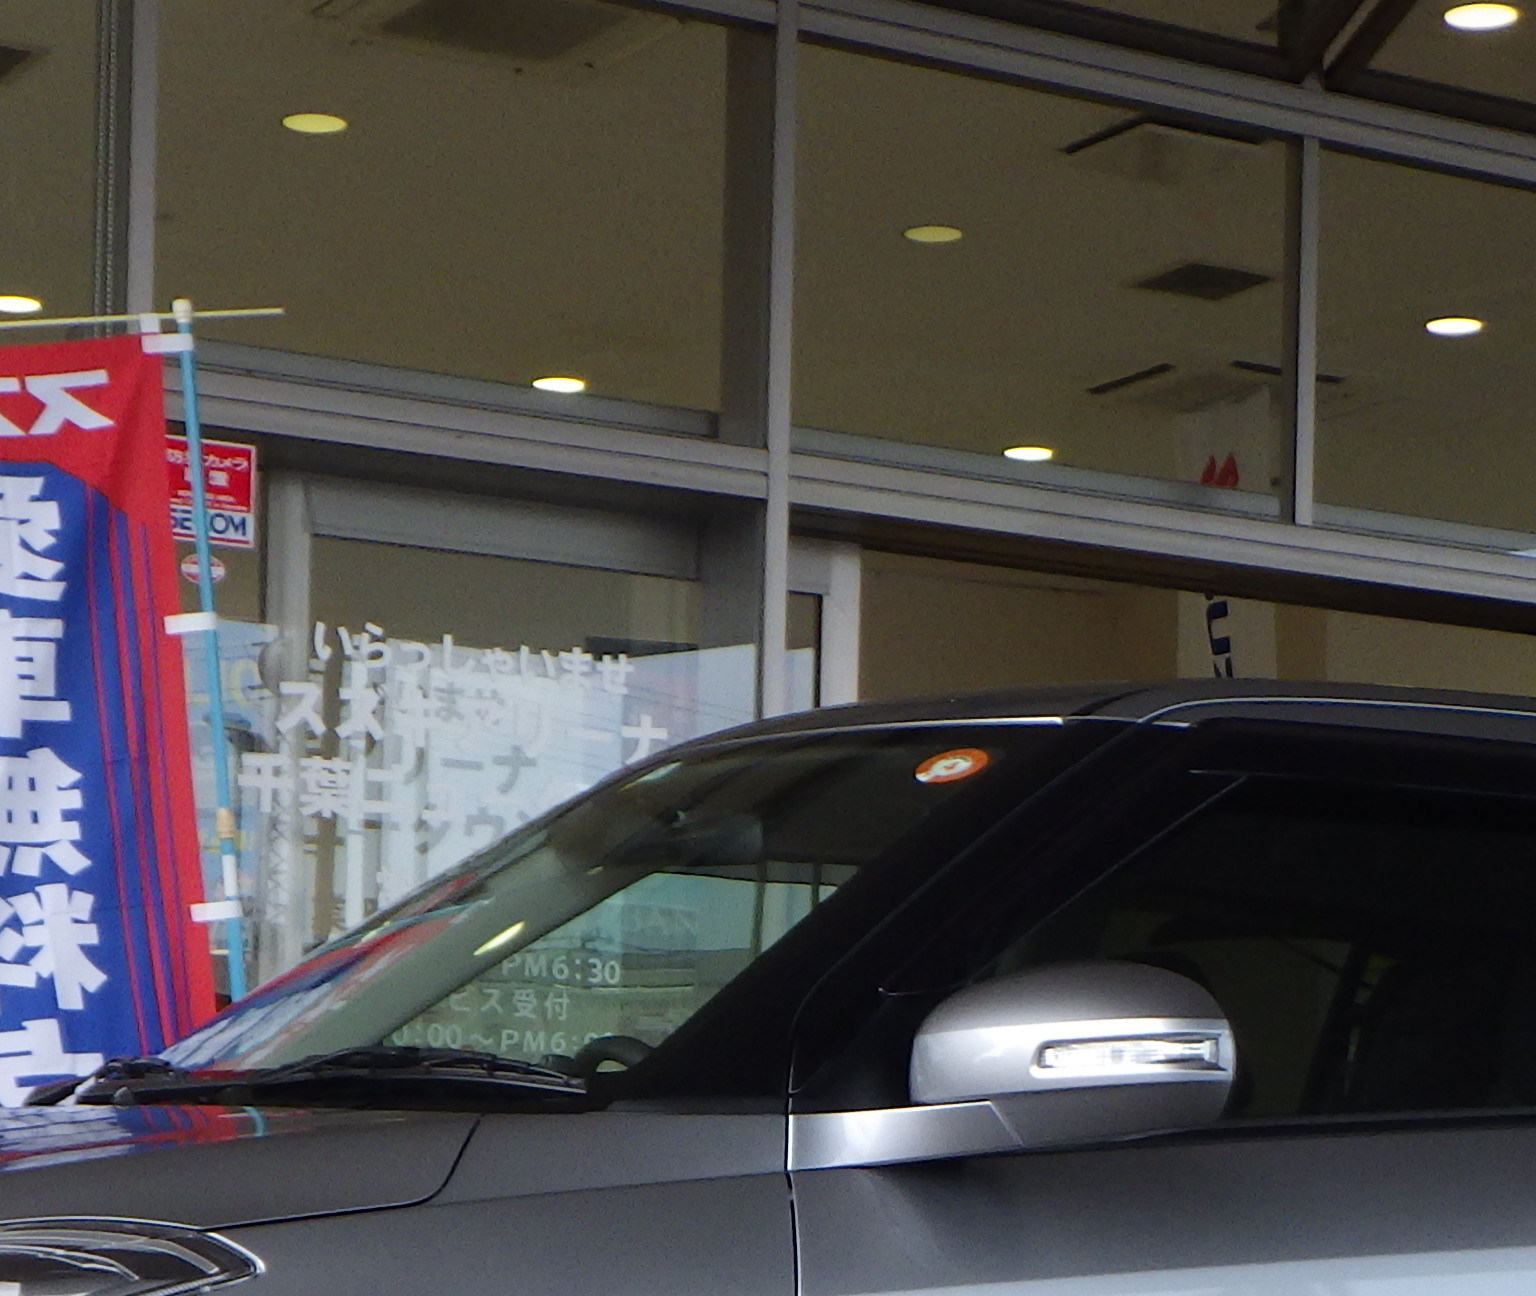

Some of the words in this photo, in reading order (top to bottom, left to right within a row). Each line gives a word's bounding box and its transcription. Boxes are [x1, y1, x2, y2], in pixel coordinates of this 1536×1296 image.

[171, 507, 247, 537] SEOM
[314, 621, 634, 694] いらっしゃいませ
